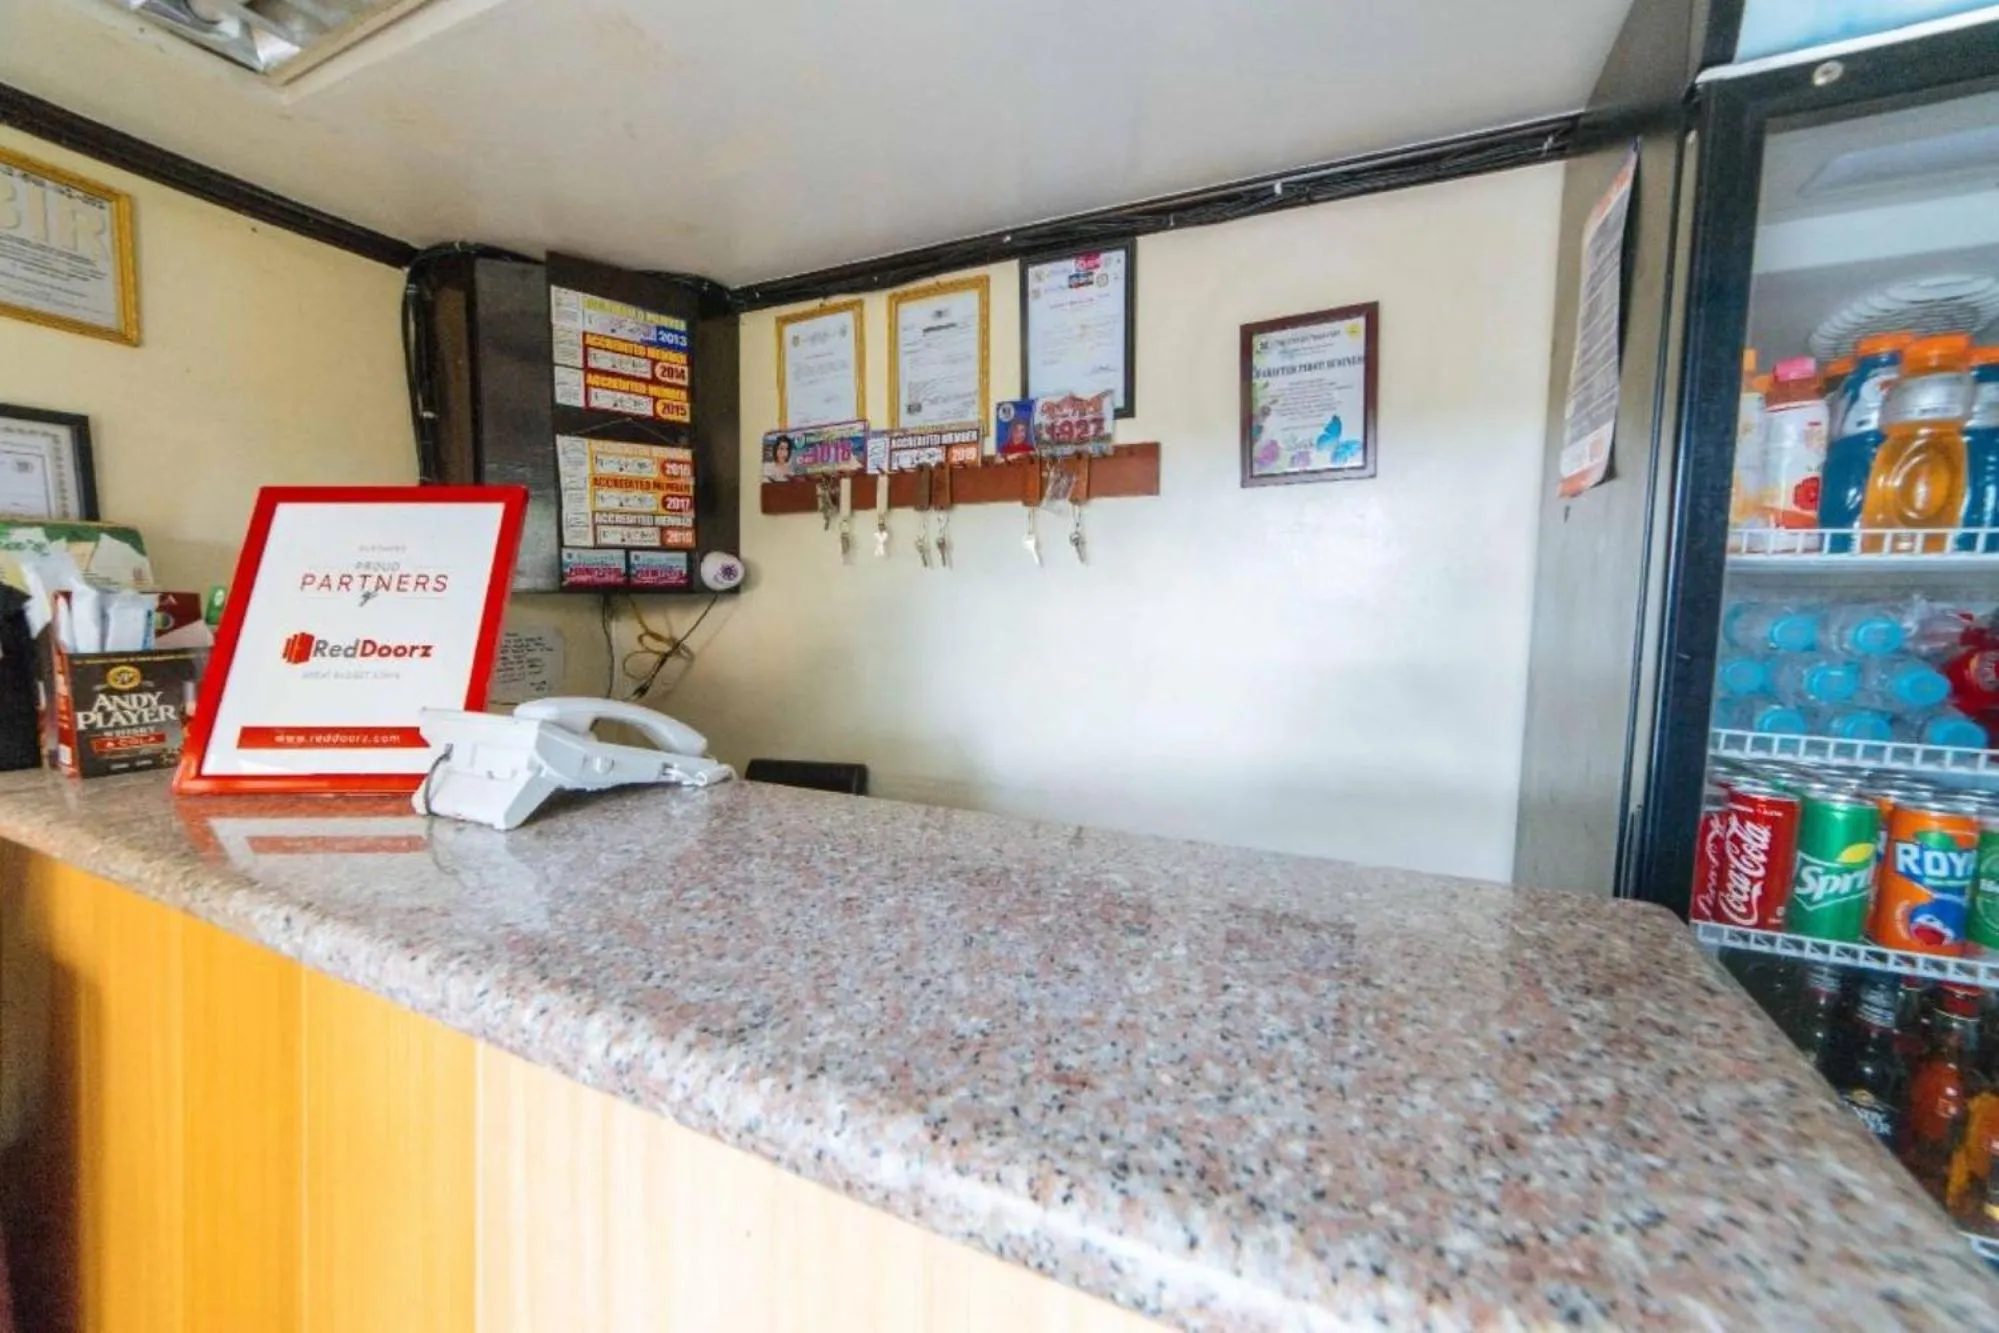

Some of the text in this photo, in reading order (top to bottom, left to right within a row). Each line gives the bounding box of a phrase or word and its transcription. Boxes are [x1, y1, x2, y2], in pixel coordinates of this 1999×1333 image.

[658, 330, 688, 347] 2013
[661, 400, 687, 417] 2015
[891, 430, 978, 449] ACCREDITED MEMBER
[593, 477, 649, 491] ACCREDITED
[666, 495, 691, 511] 2017
[595, 511, 653, 526] ACCREDITED
[355, 561, 400, 572] PROUD
[299, 573, 449, 594] PARTNERS
[312, 637, 434, 659] RedDoorz
[92, 691, 163, 713] ANDY
[76, 704, 178, 731] PLAYER
[274, 732, 400, 744] www.reddoorz.com
